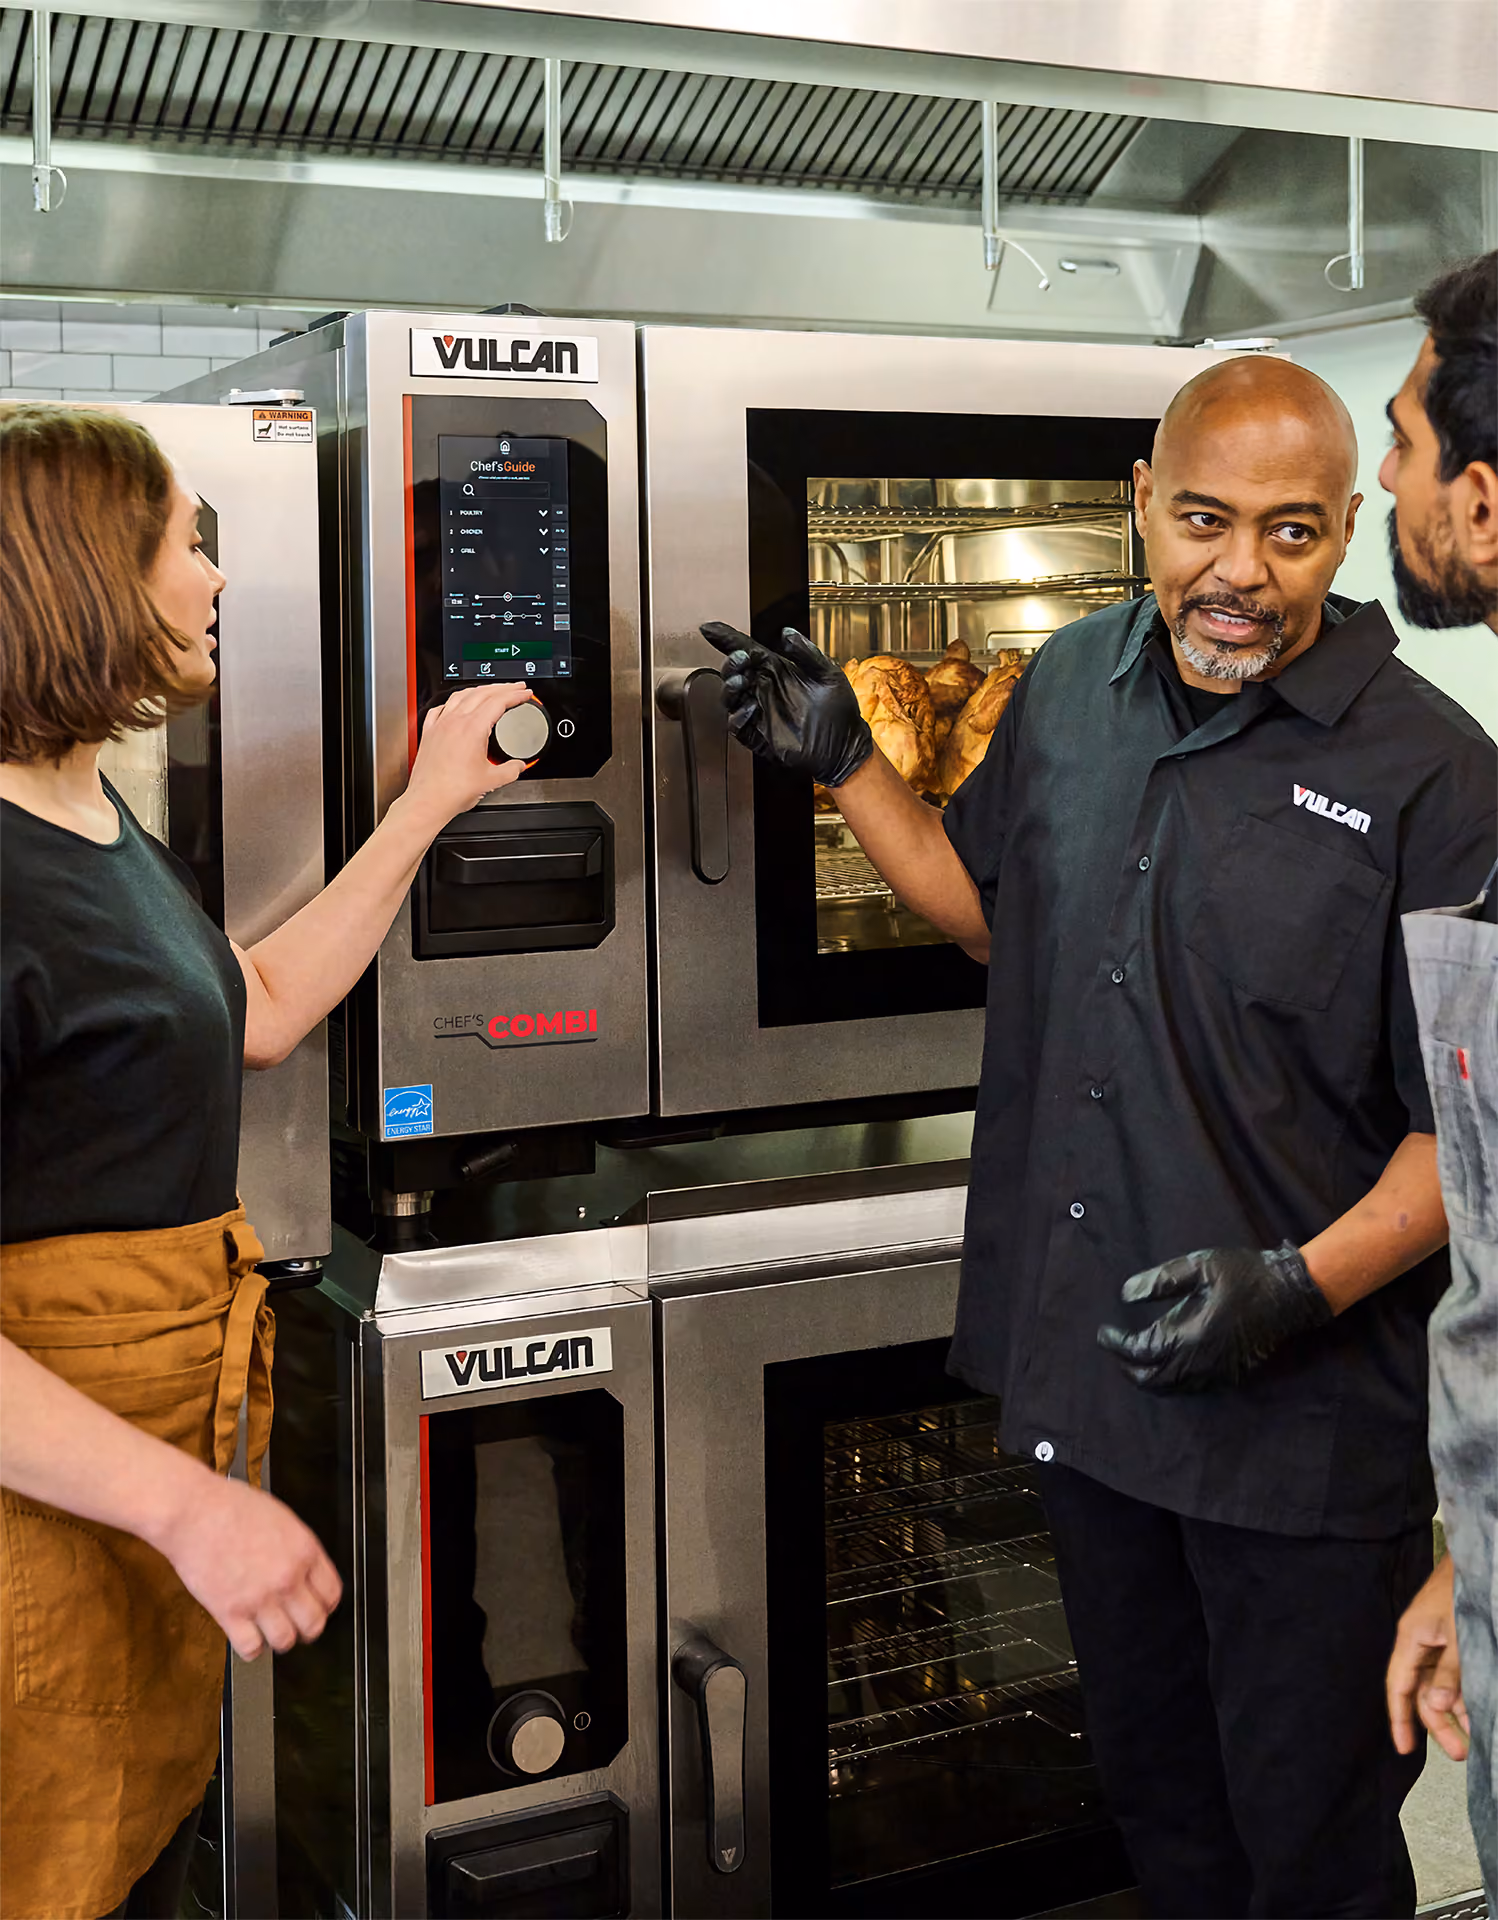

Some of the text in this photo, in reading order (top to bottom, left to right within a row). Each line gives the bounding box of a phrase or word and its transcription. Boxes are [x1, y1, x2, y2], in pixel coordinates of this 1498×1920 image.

[432, 335, 578, 374] VULCAN
[269, 412, 308, 420] WARNING
[1293, 783, 1372, 834] VULCAN
[433, 1009, 598, 1039] CHEF'S COMBI
[387, 1124, 431, 1136] ENERGY STAR
[445, 1336, 594, 1386] VULCAN
